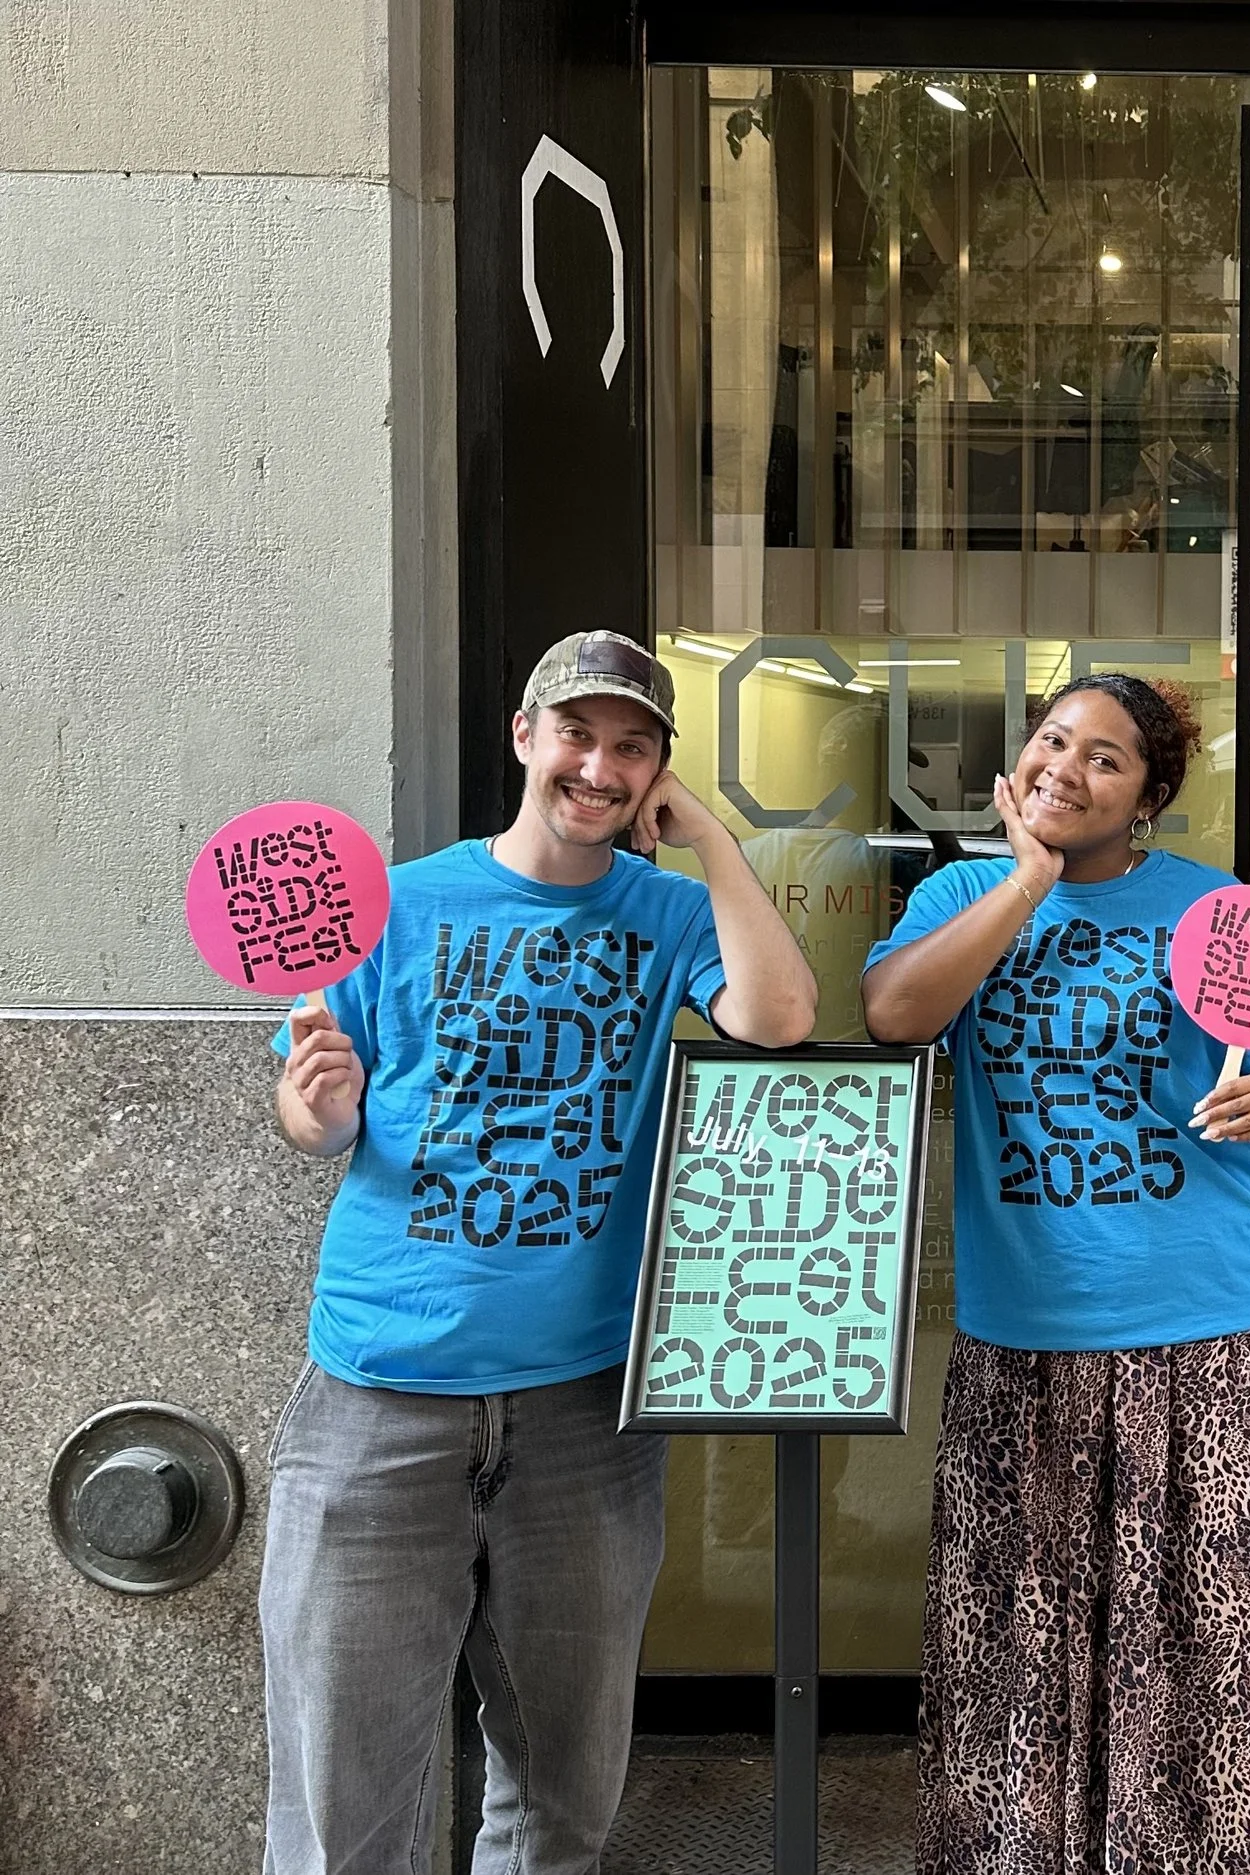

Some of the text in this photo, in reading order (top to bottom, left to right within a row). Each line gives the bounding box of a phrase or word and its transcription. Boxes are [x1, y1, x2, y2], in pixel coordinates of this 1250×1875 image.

[687, 1115, 767, 1165] July
[999, 1127, 1186, 1209] 2025
[406, 1162, 624, 1249] 2025
[644, 1326, 886, 1410] 2025
